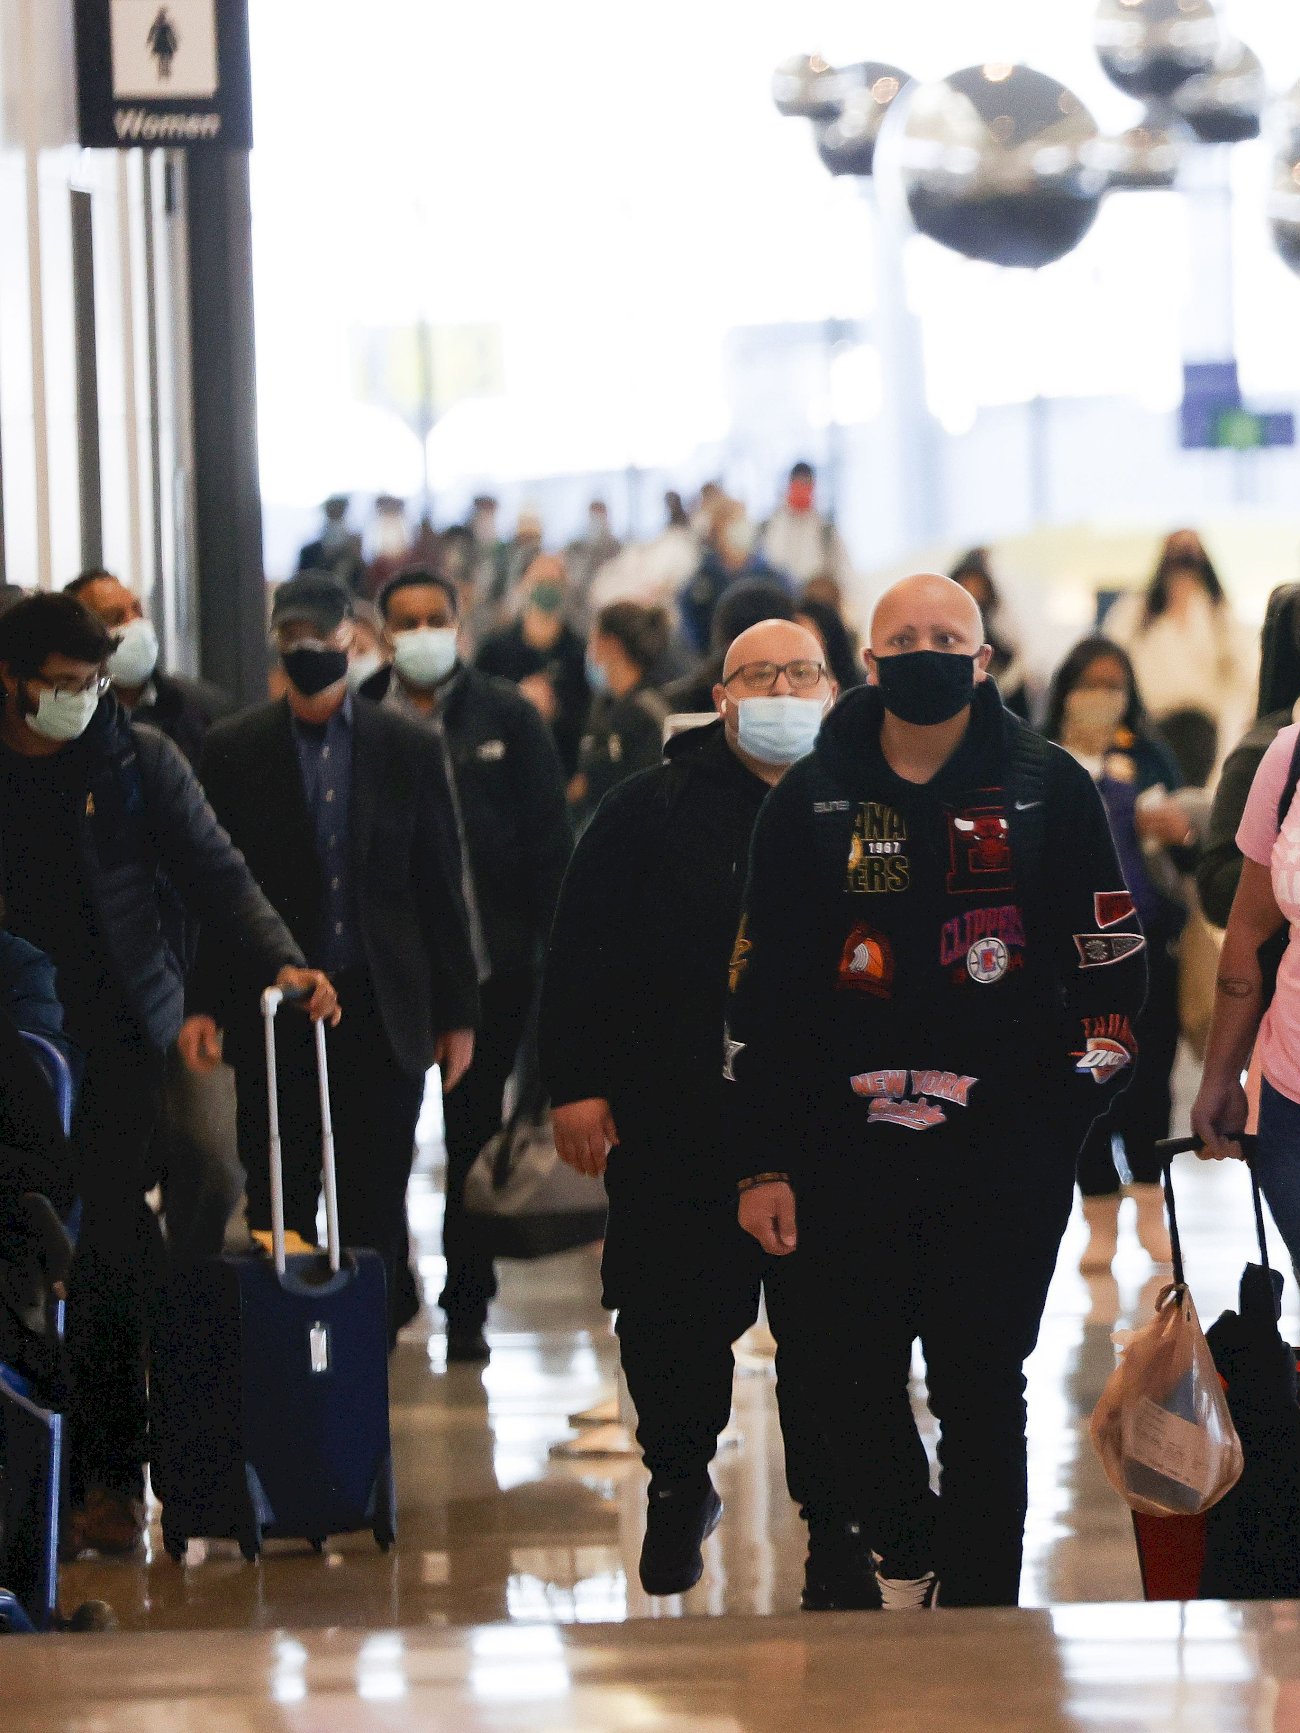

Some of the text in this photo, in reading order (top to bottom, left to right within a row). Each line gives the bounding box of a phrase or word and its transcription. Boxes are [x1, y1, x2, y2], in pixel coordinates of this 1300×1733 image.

[113, 108, 221, 140] Women
[868, 841, 901, 854] 1967
[850, 1069, 979, 1107] NEW YORK
